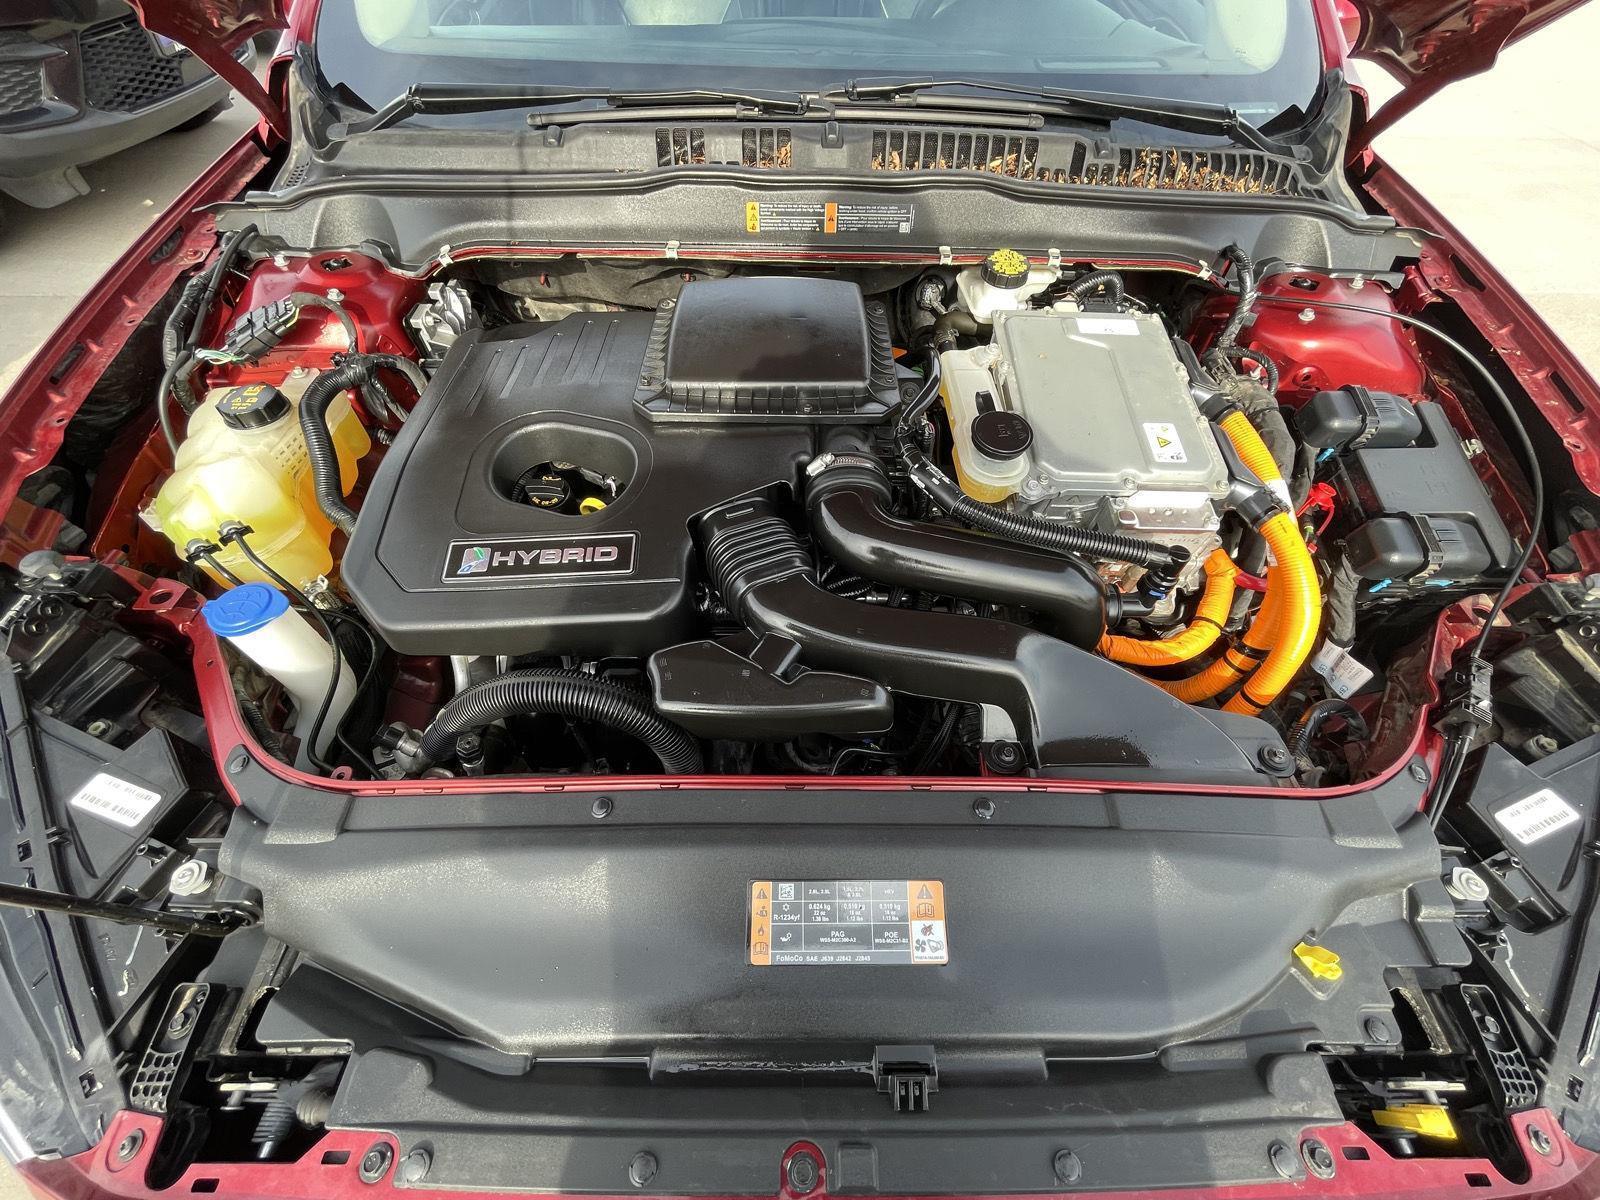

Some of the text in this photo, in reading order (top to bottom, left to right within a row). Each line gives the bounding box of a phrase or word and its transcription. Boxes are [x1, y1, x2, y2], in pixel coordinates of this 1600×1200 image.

[492, 546, 618, 567] HYBRID
[773, 914, 800, 922] R-1234yf
[830, 930, 845, 938] PAG
[776, 954, 804, 962] FoMoCo
